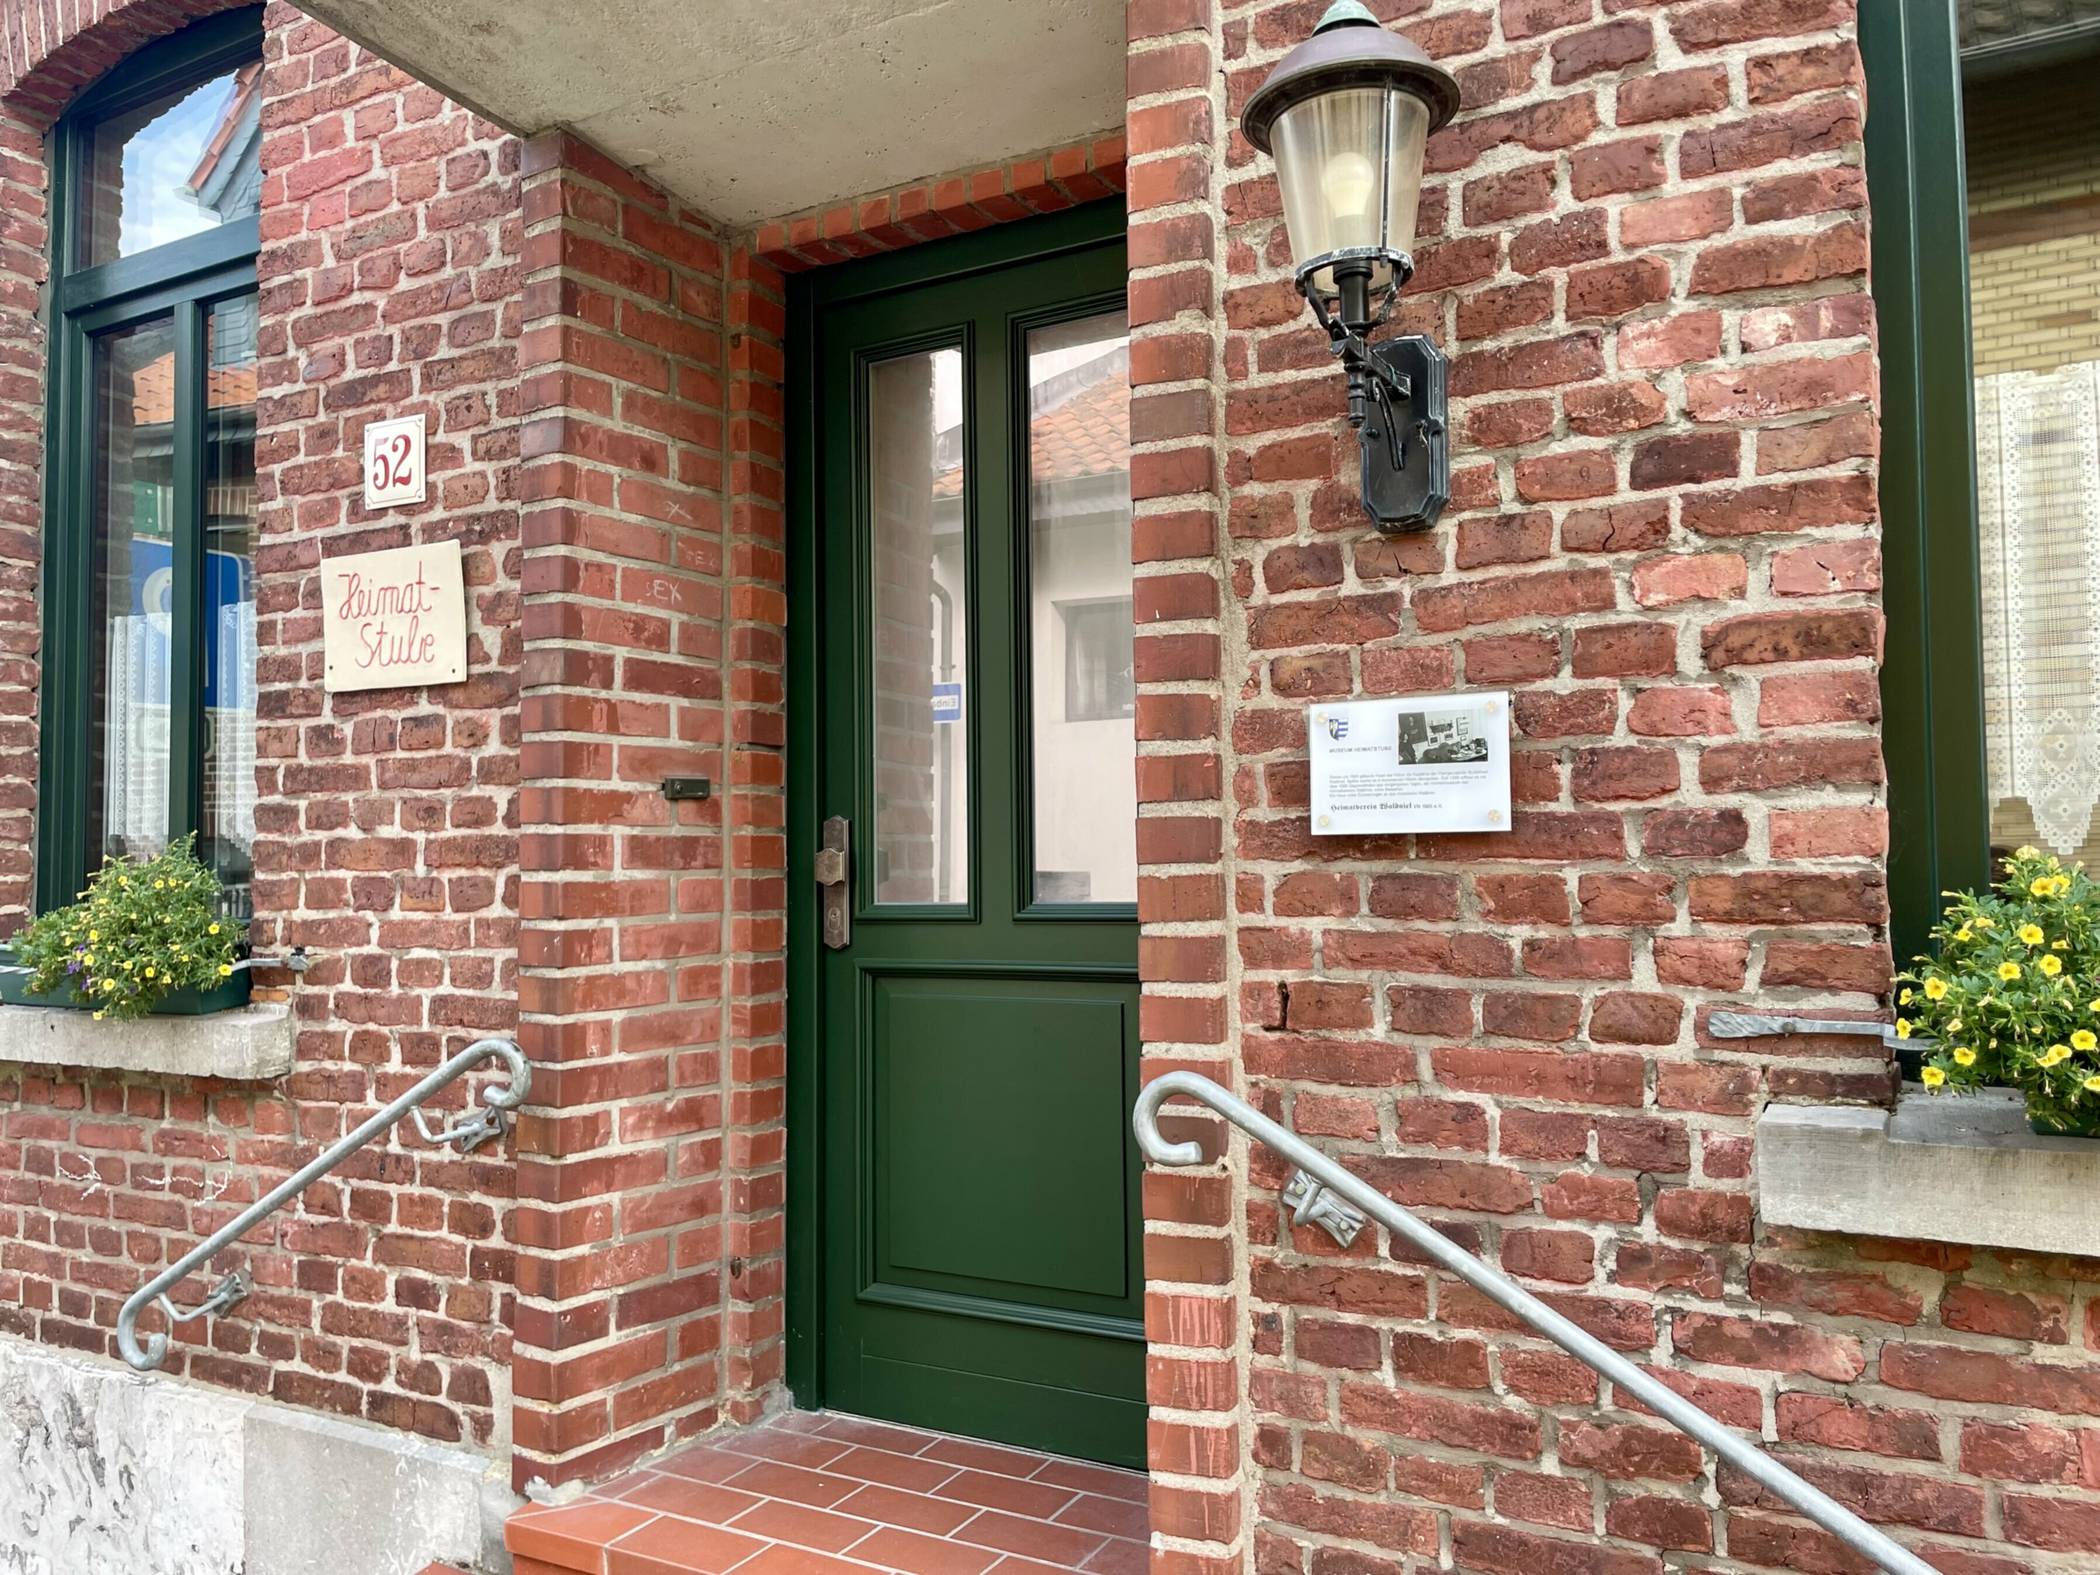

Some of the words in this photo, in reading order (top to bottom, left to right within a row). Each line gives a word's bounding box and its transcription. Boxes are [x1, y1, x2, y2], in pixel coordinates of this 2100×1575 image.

[372, 433, 412, 491] 52
[338, 560, 440, 620] Heimat-
[355, 615, 435, 669] Stube
